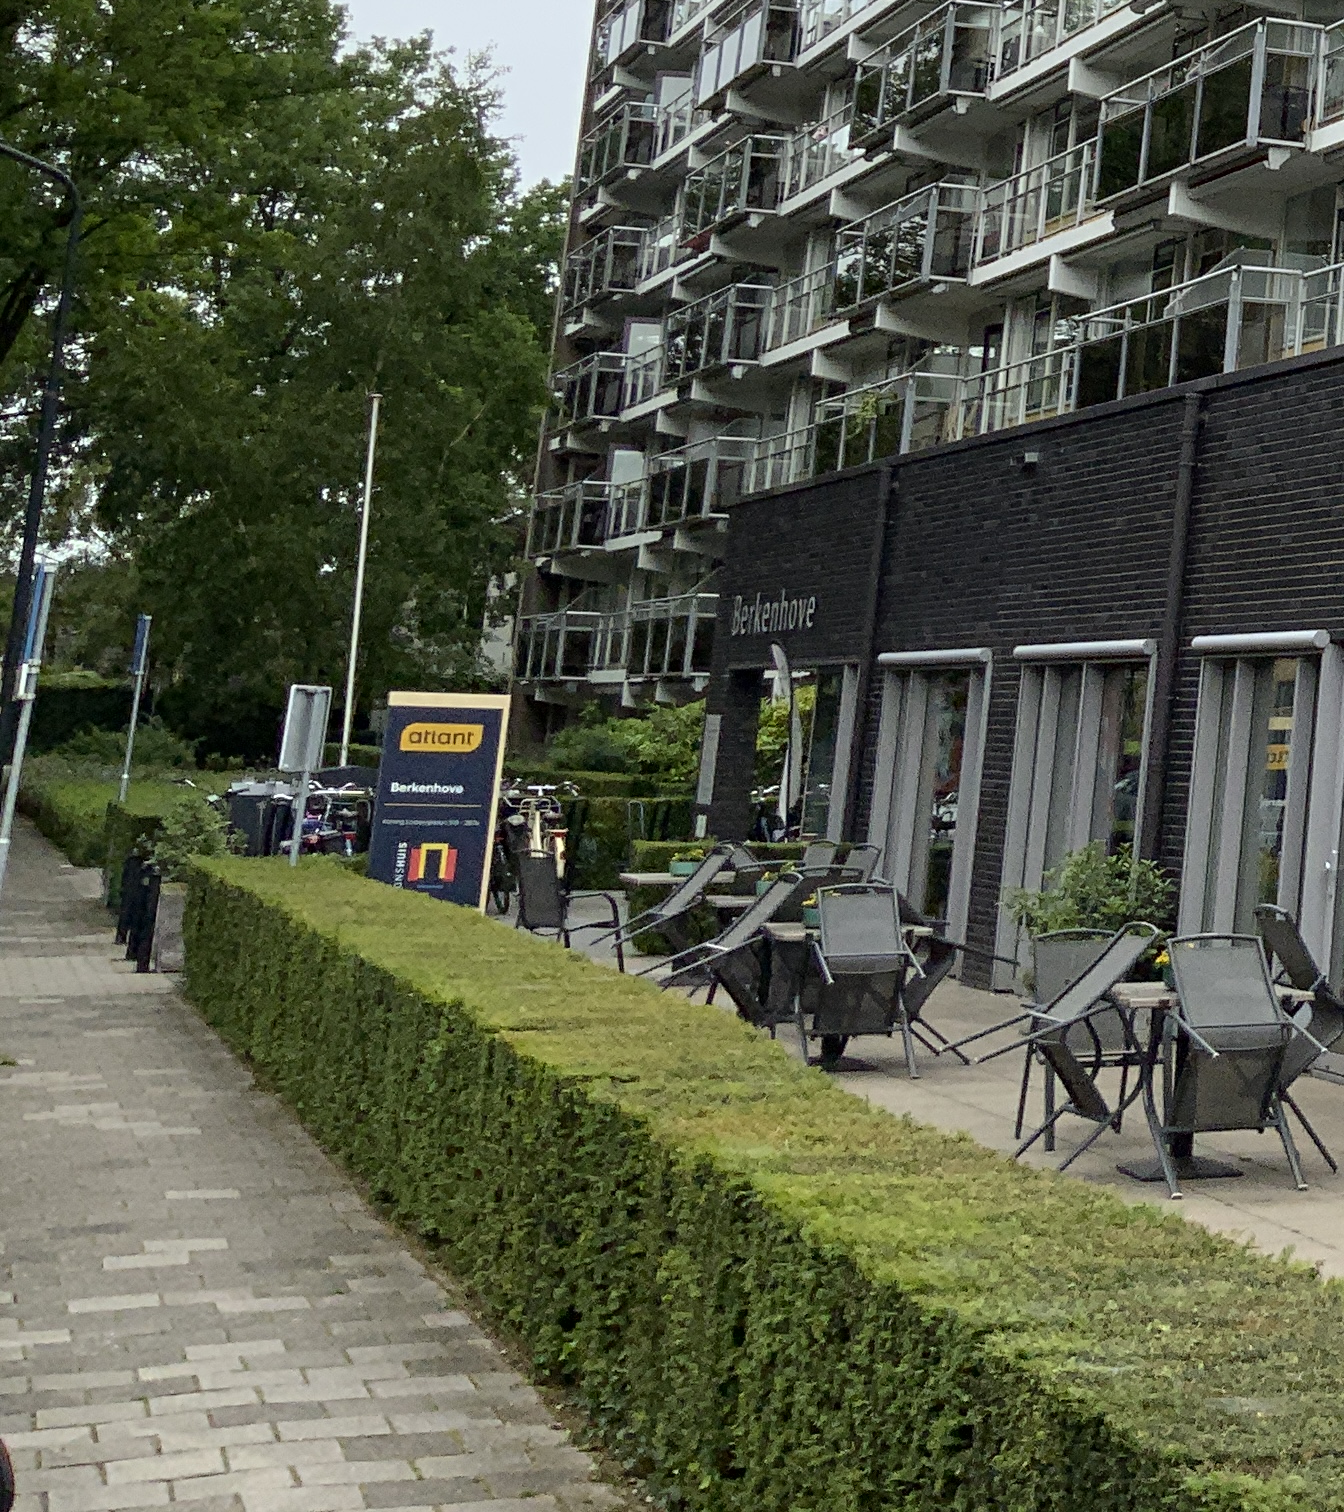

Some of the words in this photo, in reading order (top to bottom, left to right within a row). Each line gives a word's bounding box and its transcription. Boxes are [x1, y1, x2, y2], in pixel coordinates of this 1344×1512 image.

[731, 588, 816, 636] Berkenhove
[409, 729, 474, 746] atlant
[390, 781, 464, 794] Berkenhove
